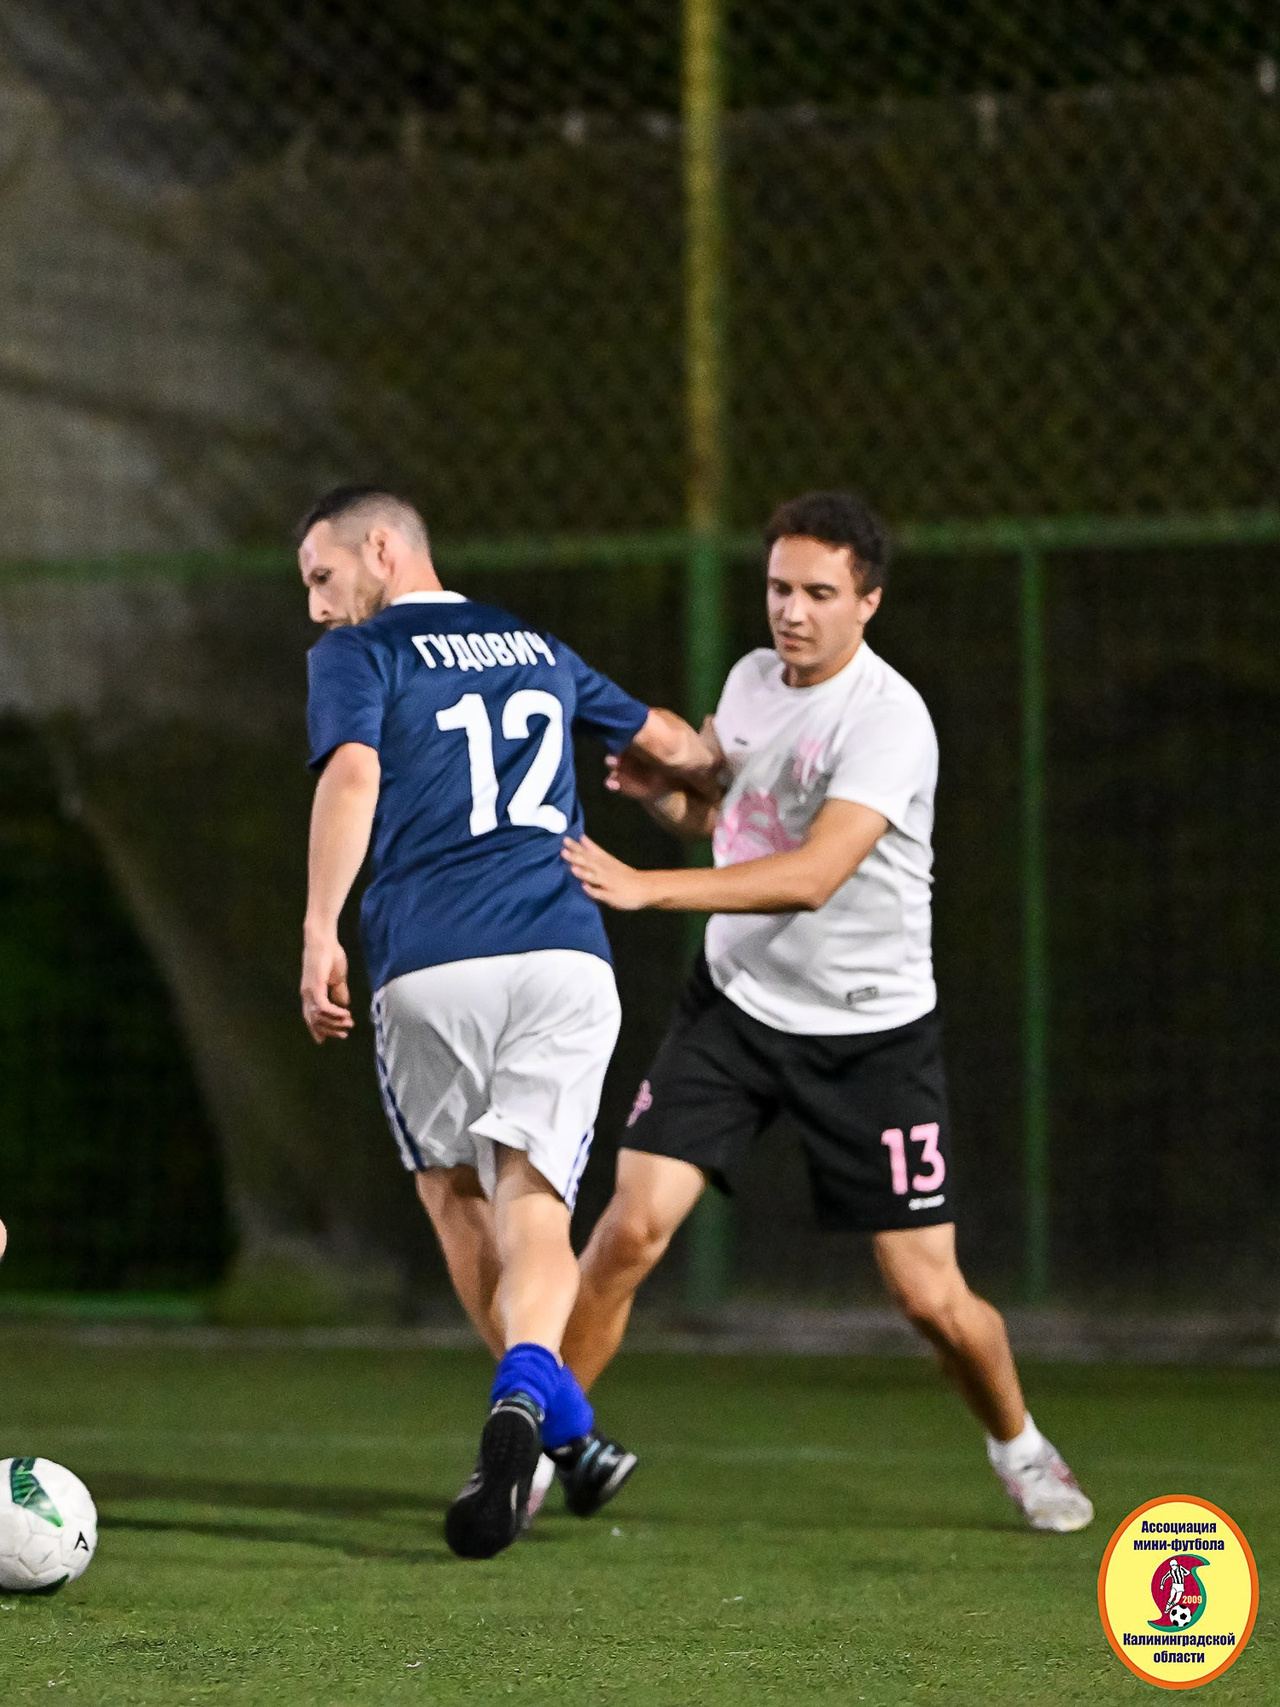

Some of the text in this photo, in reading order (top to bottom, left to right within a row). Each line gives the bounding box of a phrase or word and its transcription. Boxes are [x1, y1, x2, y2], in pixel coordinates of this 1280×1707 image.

[411, 631, 557, 672] ГУДОВИЧ
[435, 688, 568, 837] 12
[881, 1122, 946, 1195] 13
